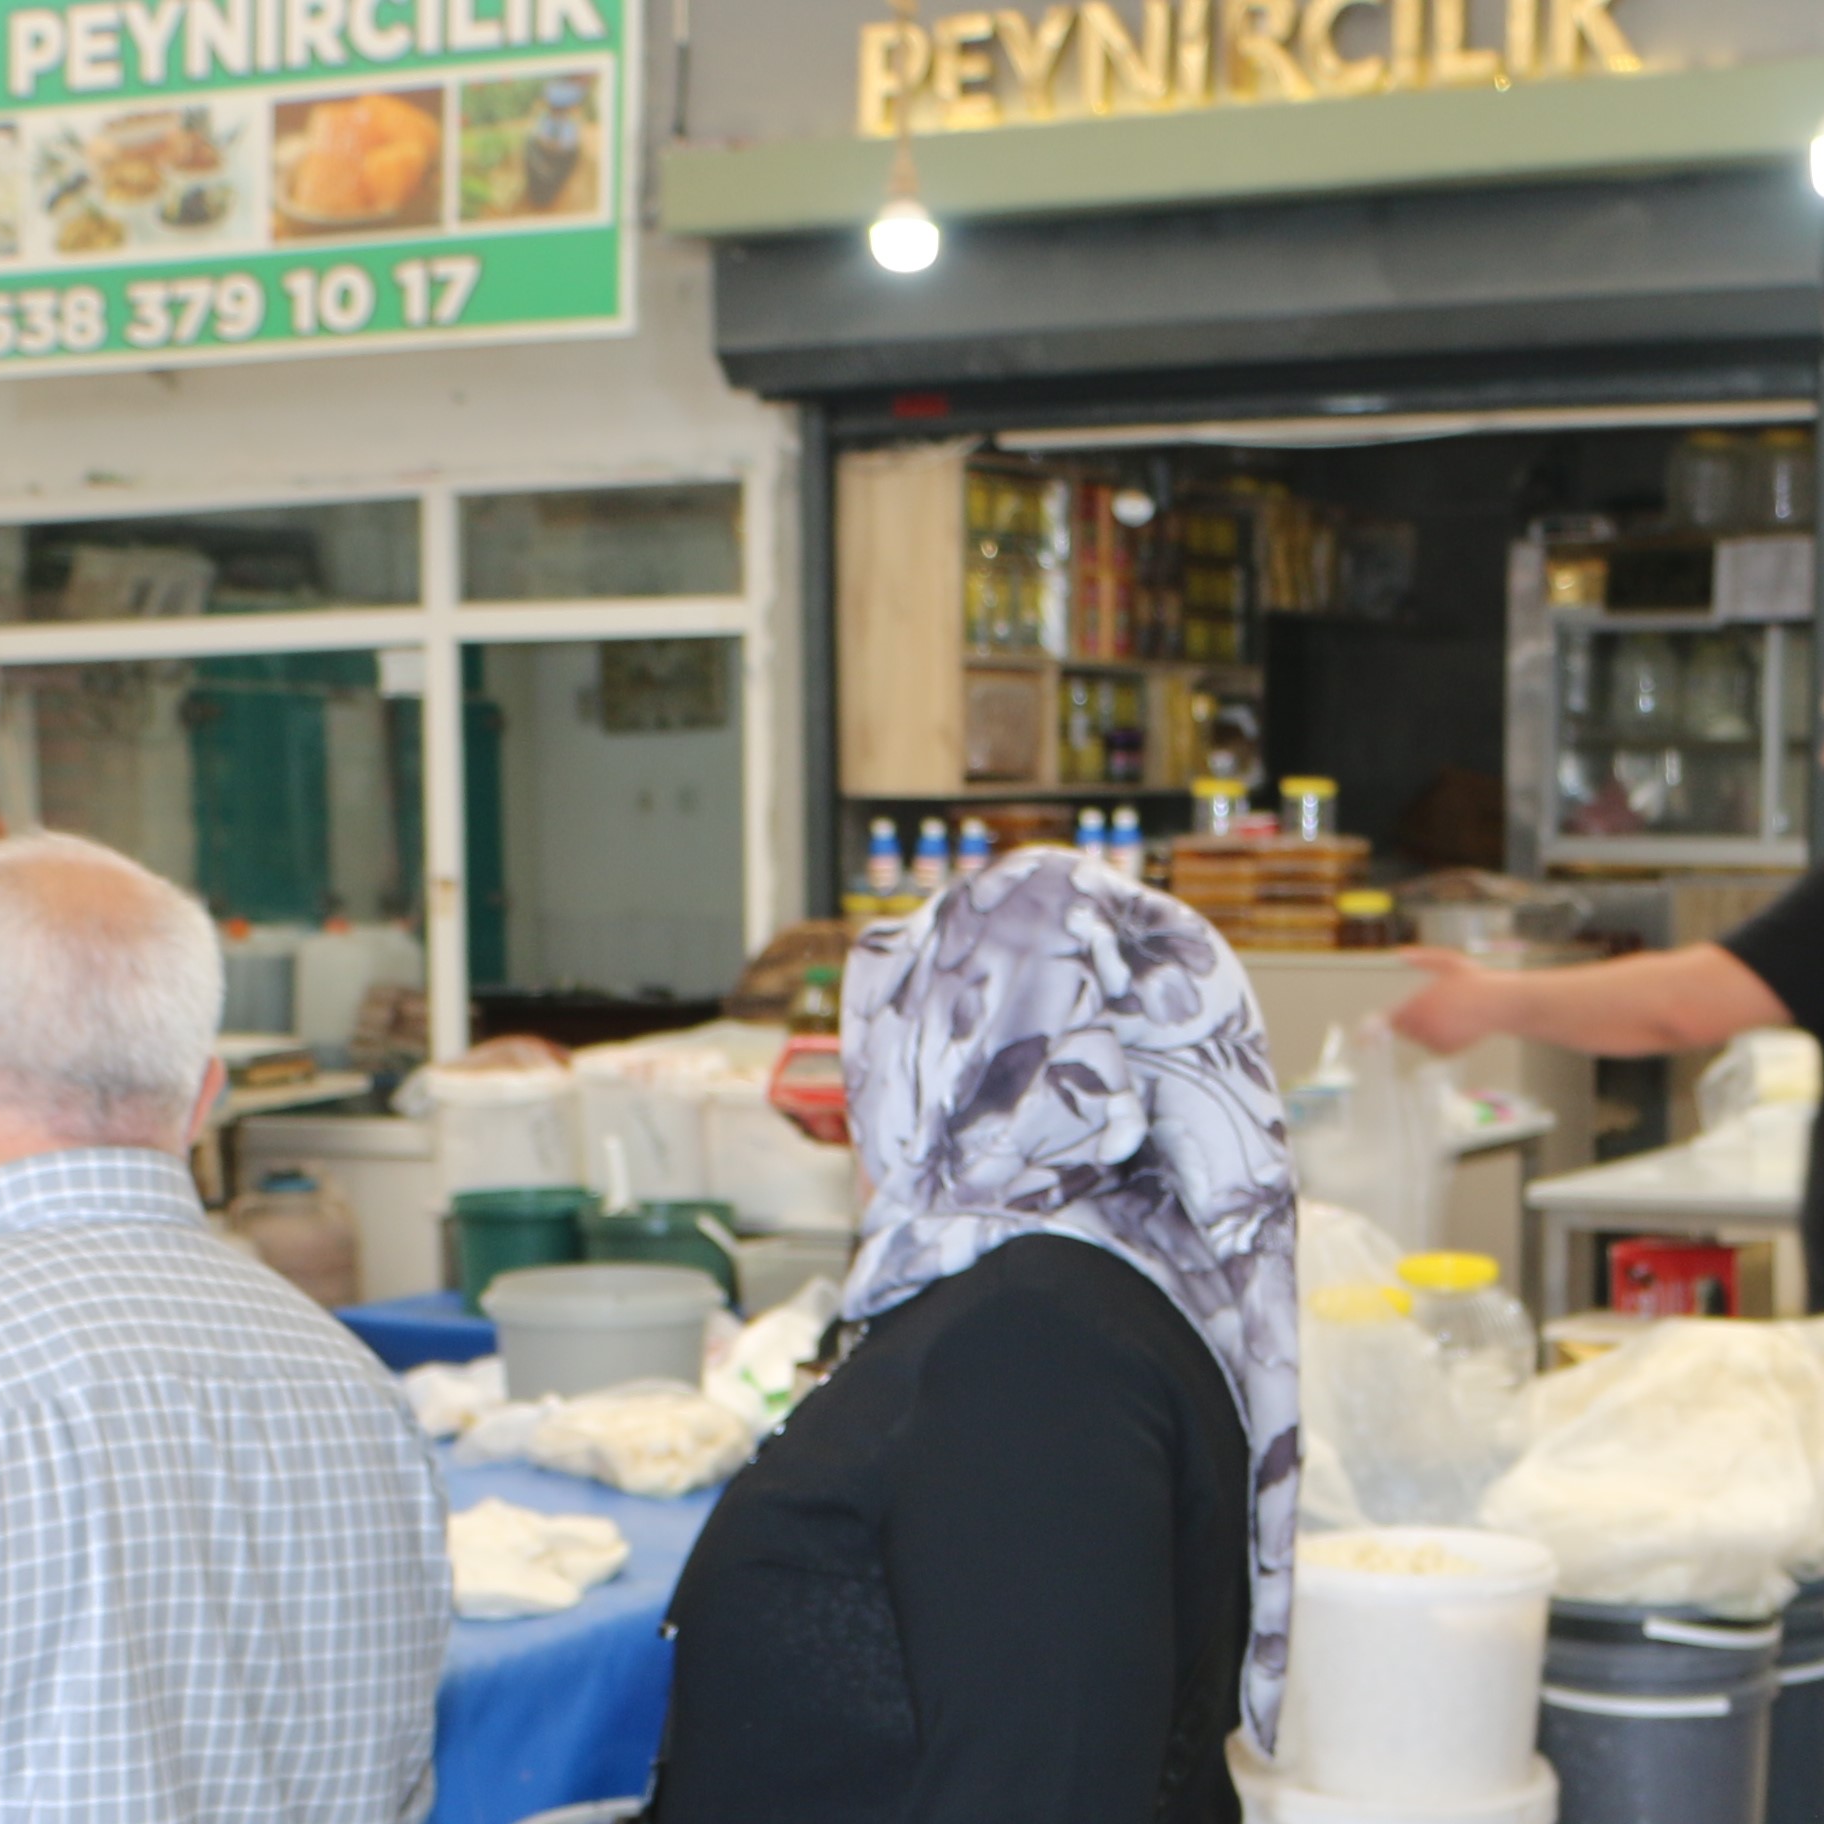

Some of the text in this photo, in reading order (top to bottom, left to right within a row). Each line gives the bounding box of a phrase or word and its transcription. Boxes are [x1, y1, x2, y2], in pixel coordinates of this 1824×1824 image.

[124, 272, 265, 349] 379
[281, 264, 376, 336] 10
[393, 254, 482, 328] 17
